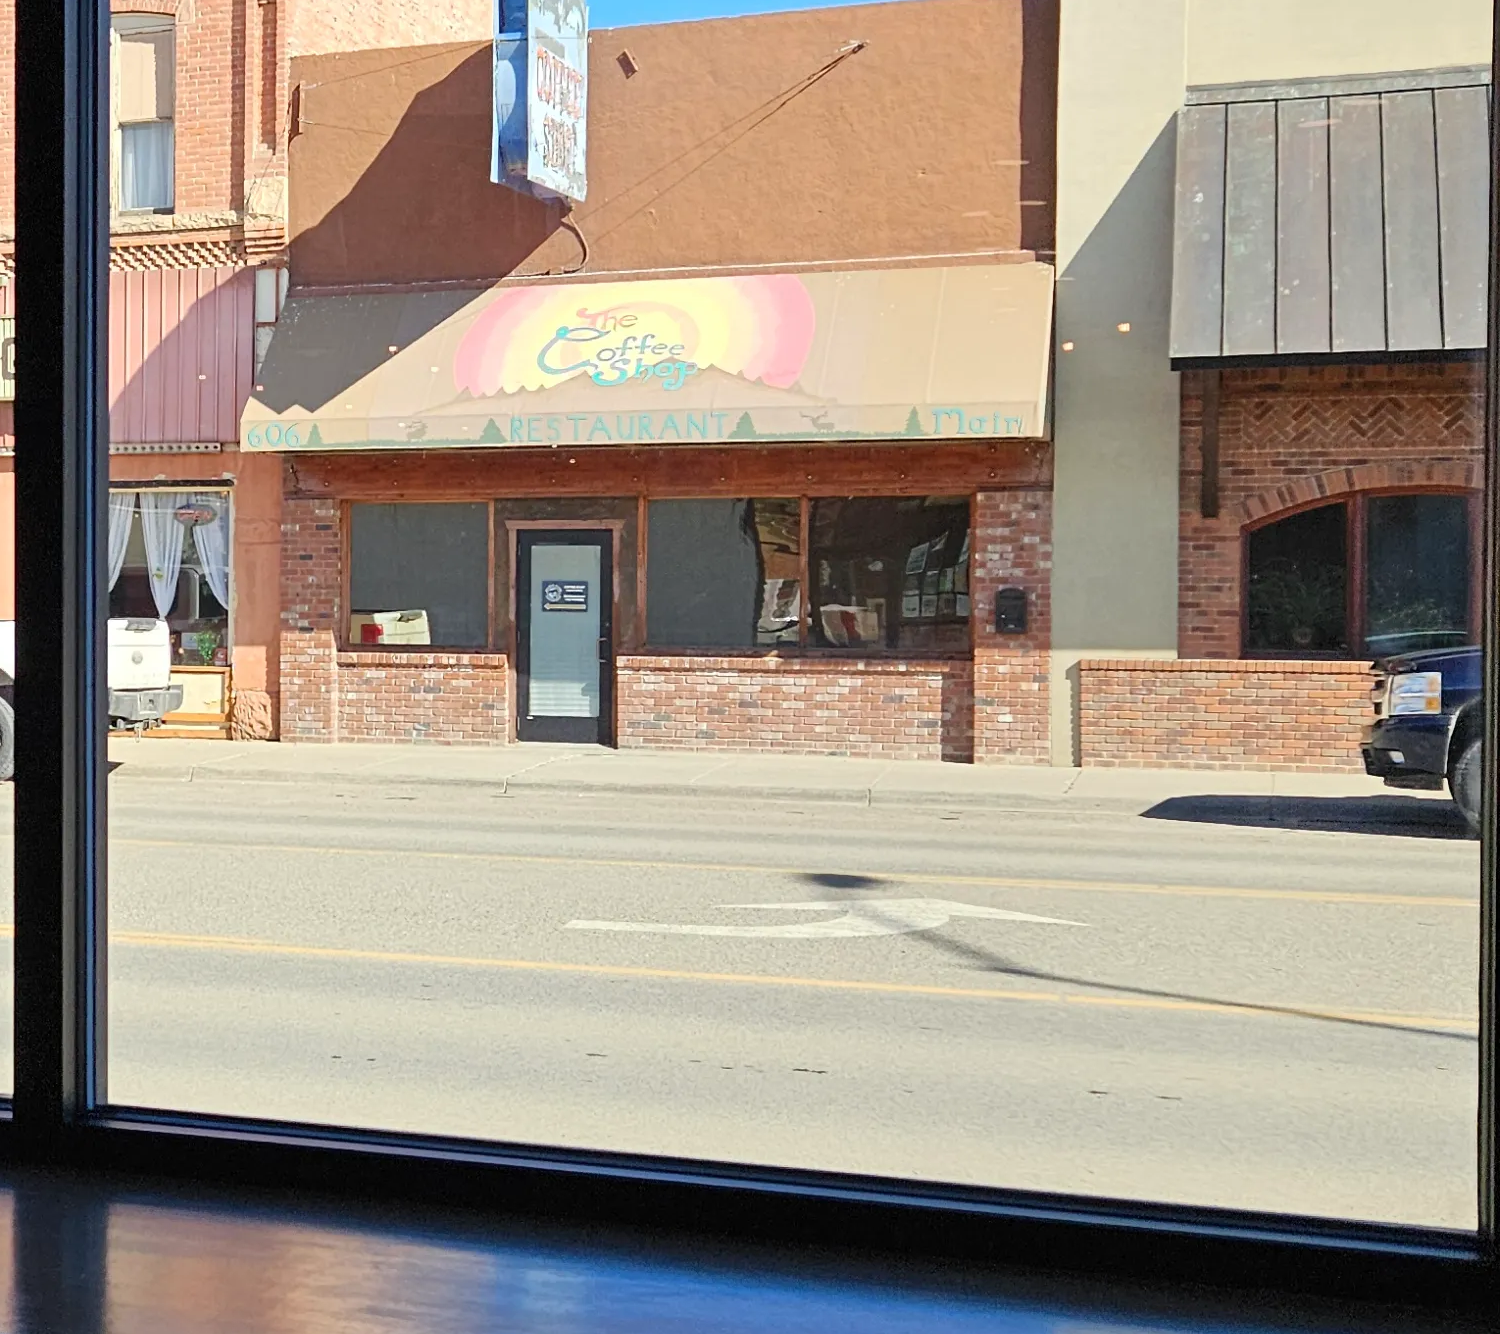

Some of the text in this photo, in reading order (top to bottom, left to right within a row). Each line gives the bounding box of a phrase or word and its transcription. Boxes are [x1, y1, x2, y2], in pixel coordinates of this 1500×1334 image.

[576, 307, 638, 331] The
[537, 326, 685, 375] Coffee
[592, 358, 698, 391] Shop
[247, 422, 302, 448] 606
[510, 411, 729, 443] RESTAURANT
[931, 407, 1023, 435] Main
